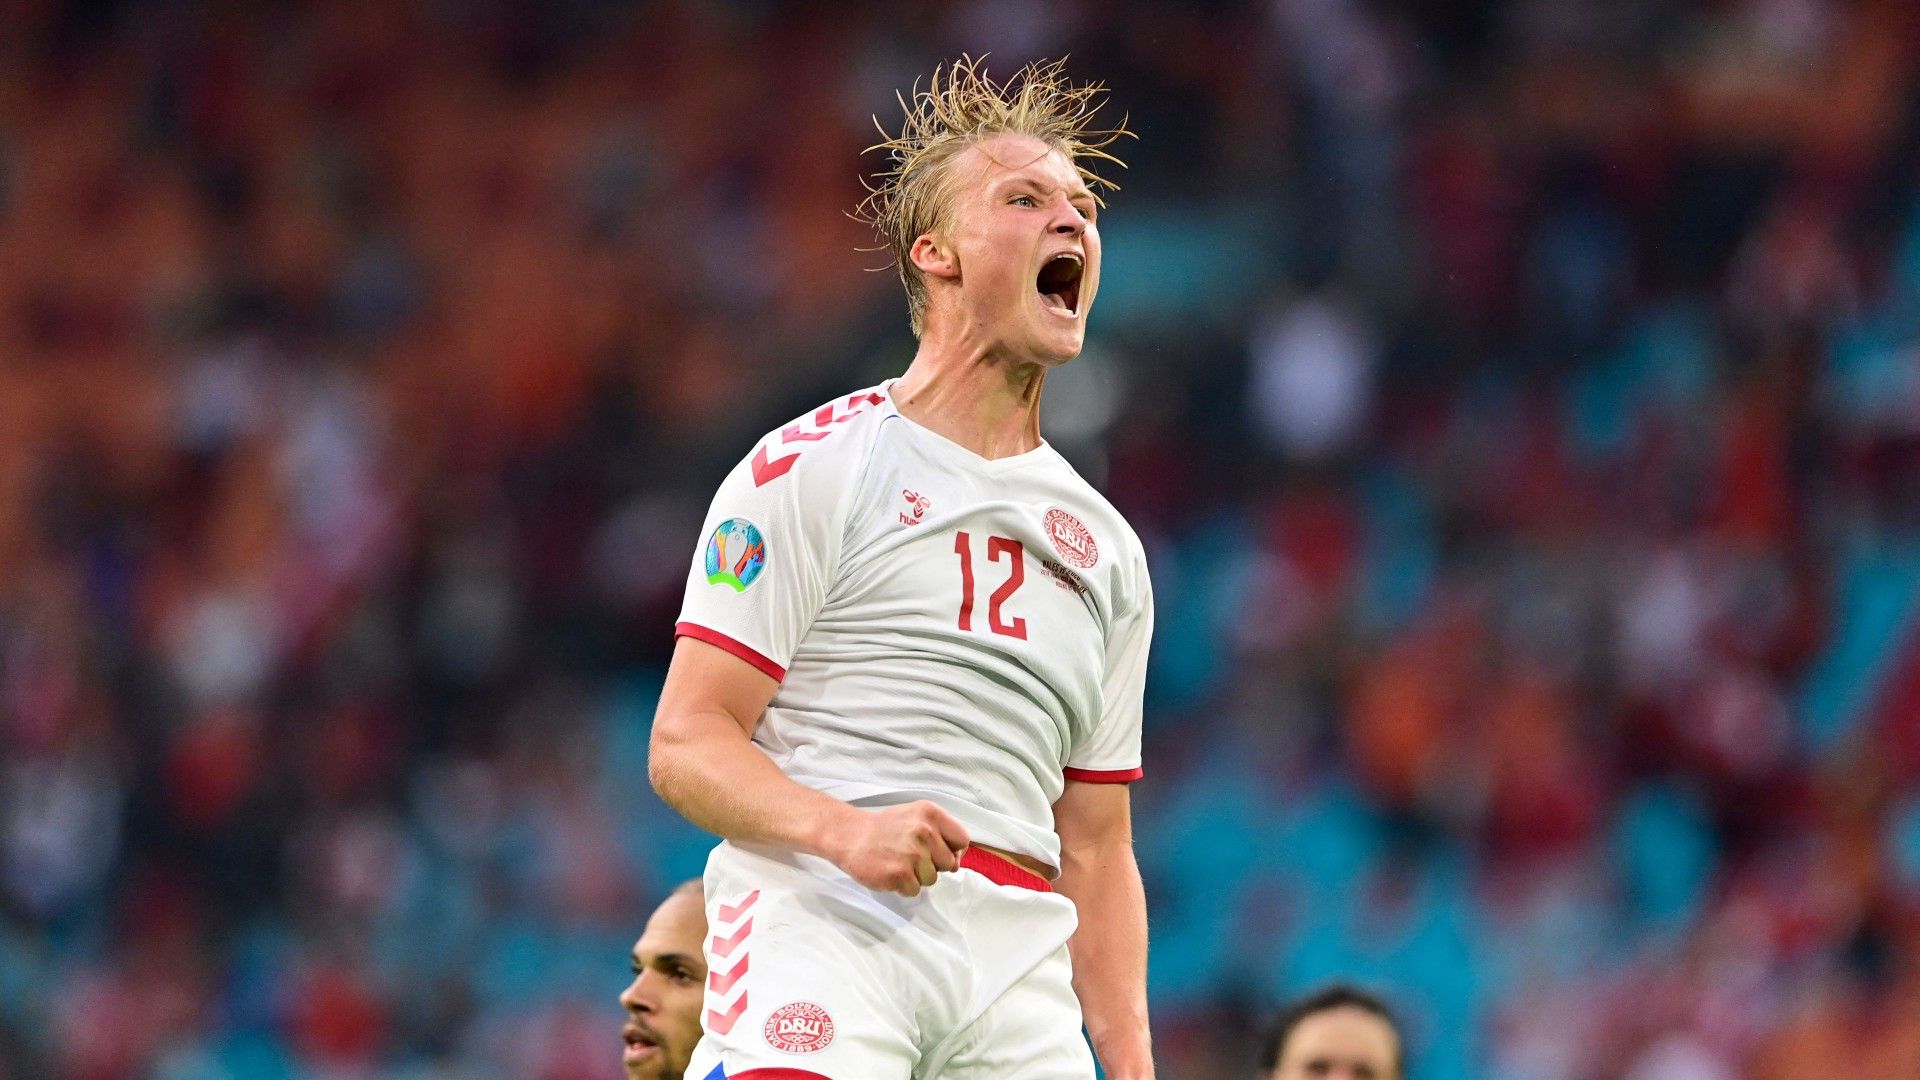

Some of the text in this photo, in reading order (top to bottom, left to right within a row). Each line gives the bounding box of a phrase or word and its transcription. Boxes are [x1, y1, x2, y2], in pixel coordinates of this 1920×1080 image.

[1054, 522, 1088, 556] DBU
[955, 531, 1028, 641] 12
[777, 1017, 821, 1037] DBU
[814, 1021, 833, 1049] UNION
